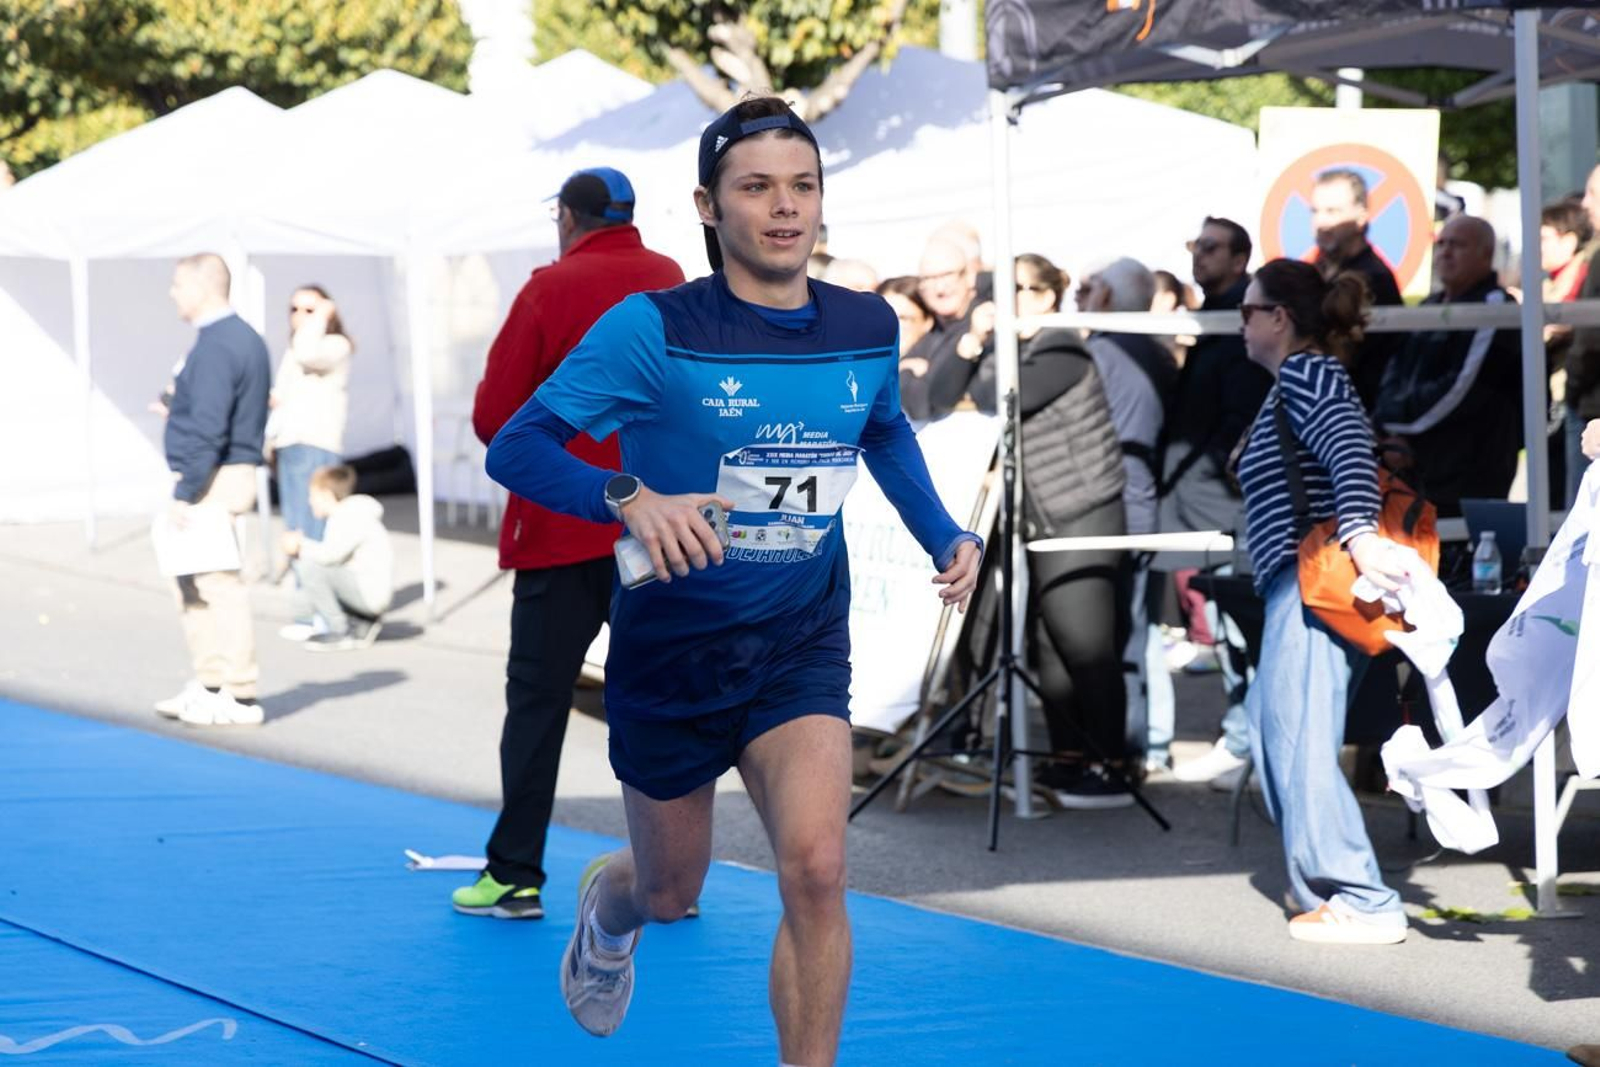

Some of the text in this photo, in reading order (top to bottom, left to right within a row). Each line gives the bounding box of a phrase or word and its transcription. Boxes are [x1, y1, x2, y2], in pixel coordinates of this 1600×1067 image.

[728, 398, 760, 407] RURAL
[802, 431, 828, 439] MEDIA
[765, 476, 817, 513] 71
[780, 513, 805, 525] JUAN
